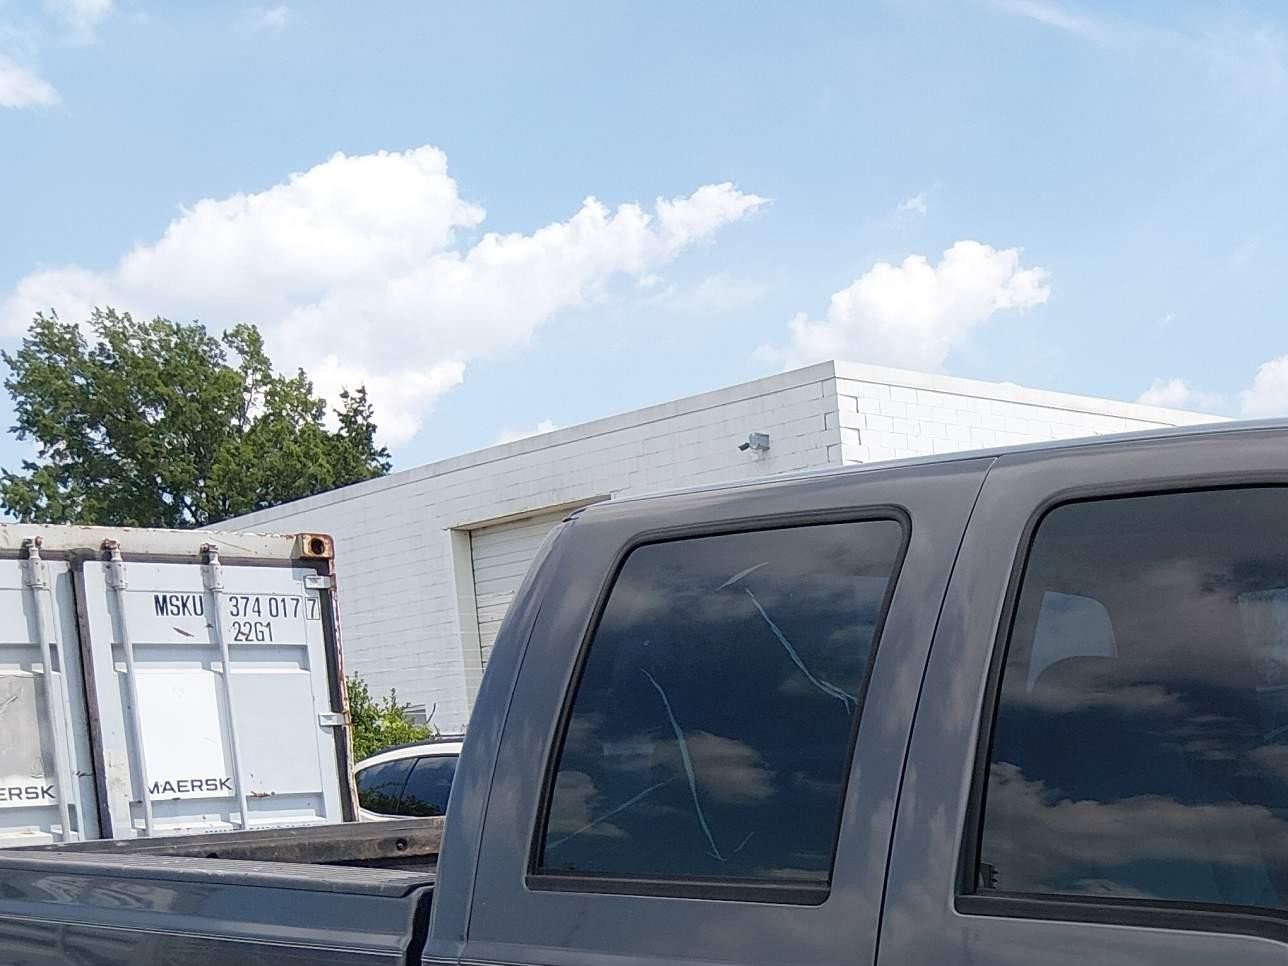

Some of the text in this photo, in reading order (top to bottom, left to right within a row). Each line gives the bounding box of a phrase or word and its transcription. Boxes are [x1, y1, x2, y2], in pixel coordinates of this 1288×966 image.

[154, 594, 205, 617] MSKU
[229, 597, 262, 618] 374
[268, 597, 301, 618] 017
[232, 621, 273, 642] 22G1
[149, 777, 233, 796] MAERSK
